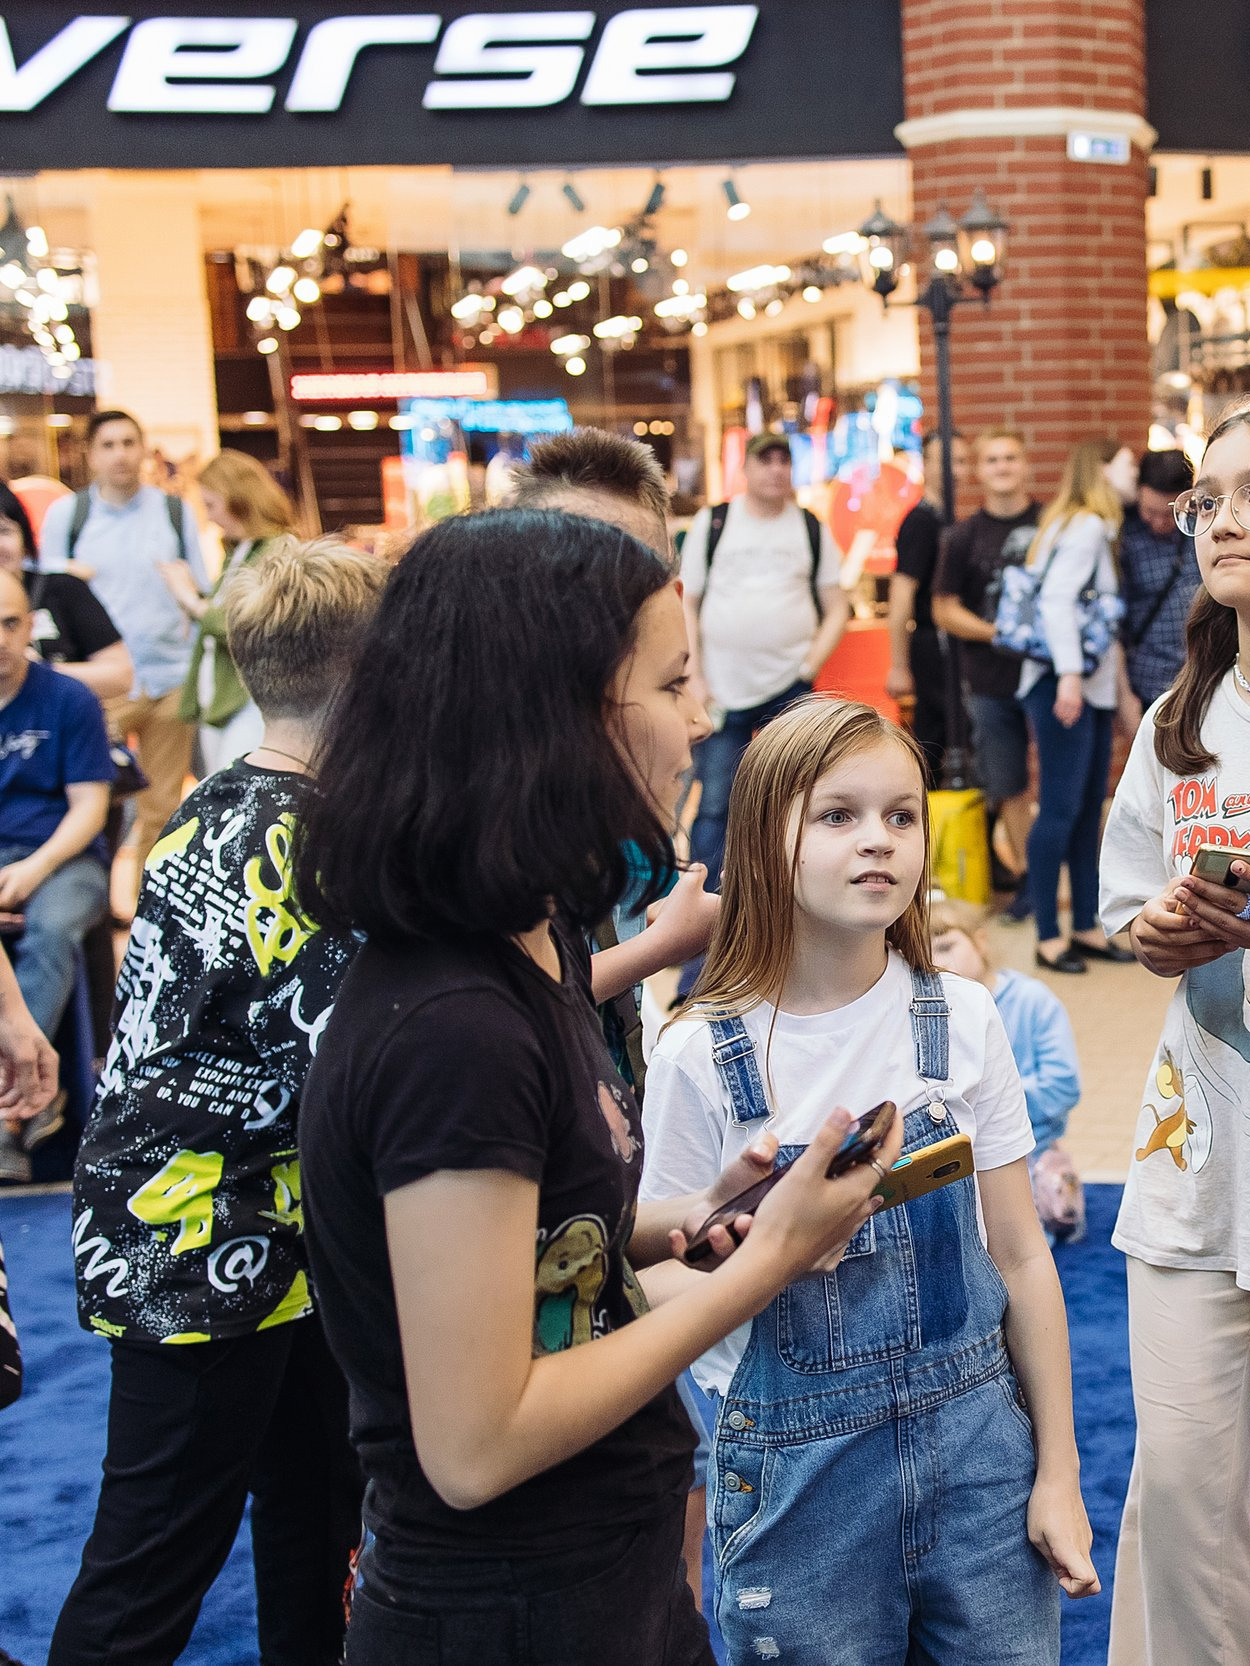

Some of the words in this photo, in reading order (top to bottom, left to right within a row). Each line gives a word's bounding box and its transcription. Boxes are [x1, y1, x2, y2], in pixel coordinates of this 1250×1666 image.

[1167, 777, 1219, 825] TOM
[195, 1067, 244, 1088] EXPLAIN
[215, 1058, 240, 1074] AND
[177, 1092, 201, 1110] YOU
[207, 1101, 234, 1117] CAN
[189, 1080, 223, 1099] WORK
[226, 1089, 253, 1105] AND
